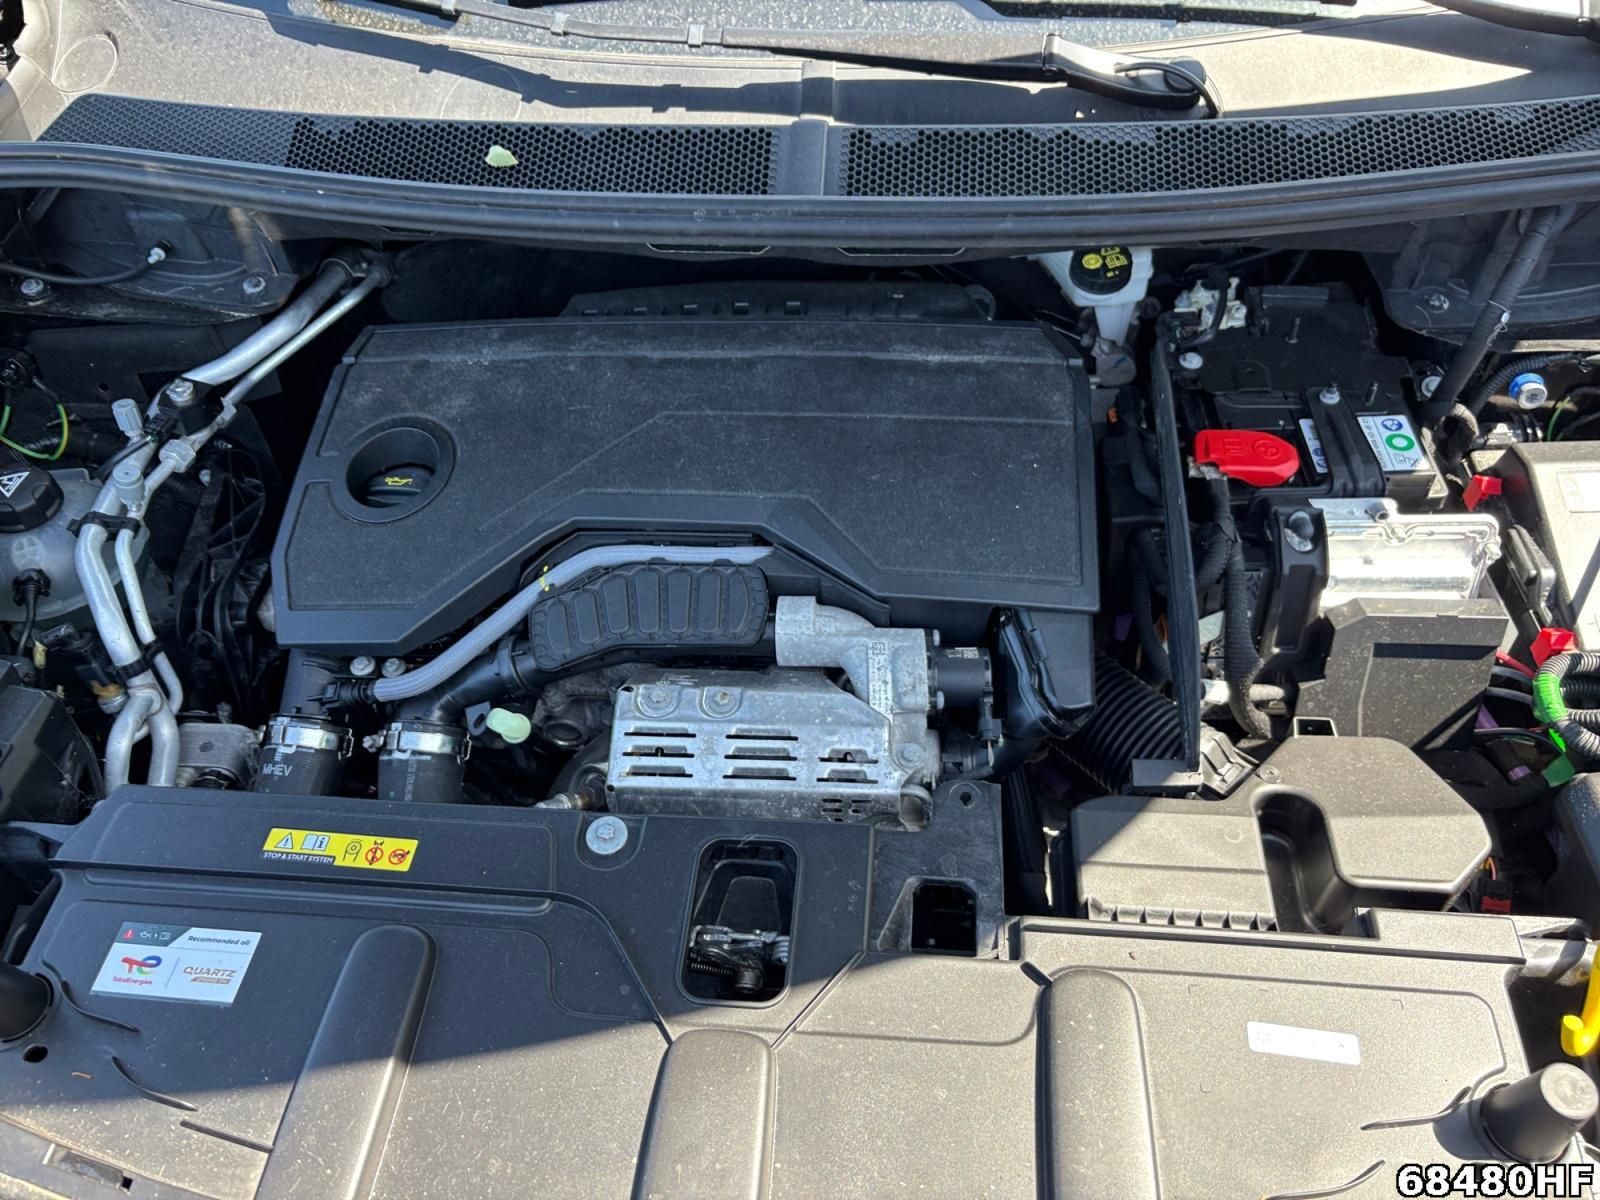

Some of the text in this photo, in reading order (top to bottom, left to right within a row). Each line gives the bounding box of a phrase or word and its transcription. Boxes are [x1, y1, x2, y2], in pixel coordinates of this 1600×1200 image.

[262, 763, 293, 777] MHEV
[287, 853, 308, 861] START
[308, 855, 334, 863] SYSTEM
[188, 935, 239, 945] Recommended
[183, 966, 237, 978] QUARTZ
